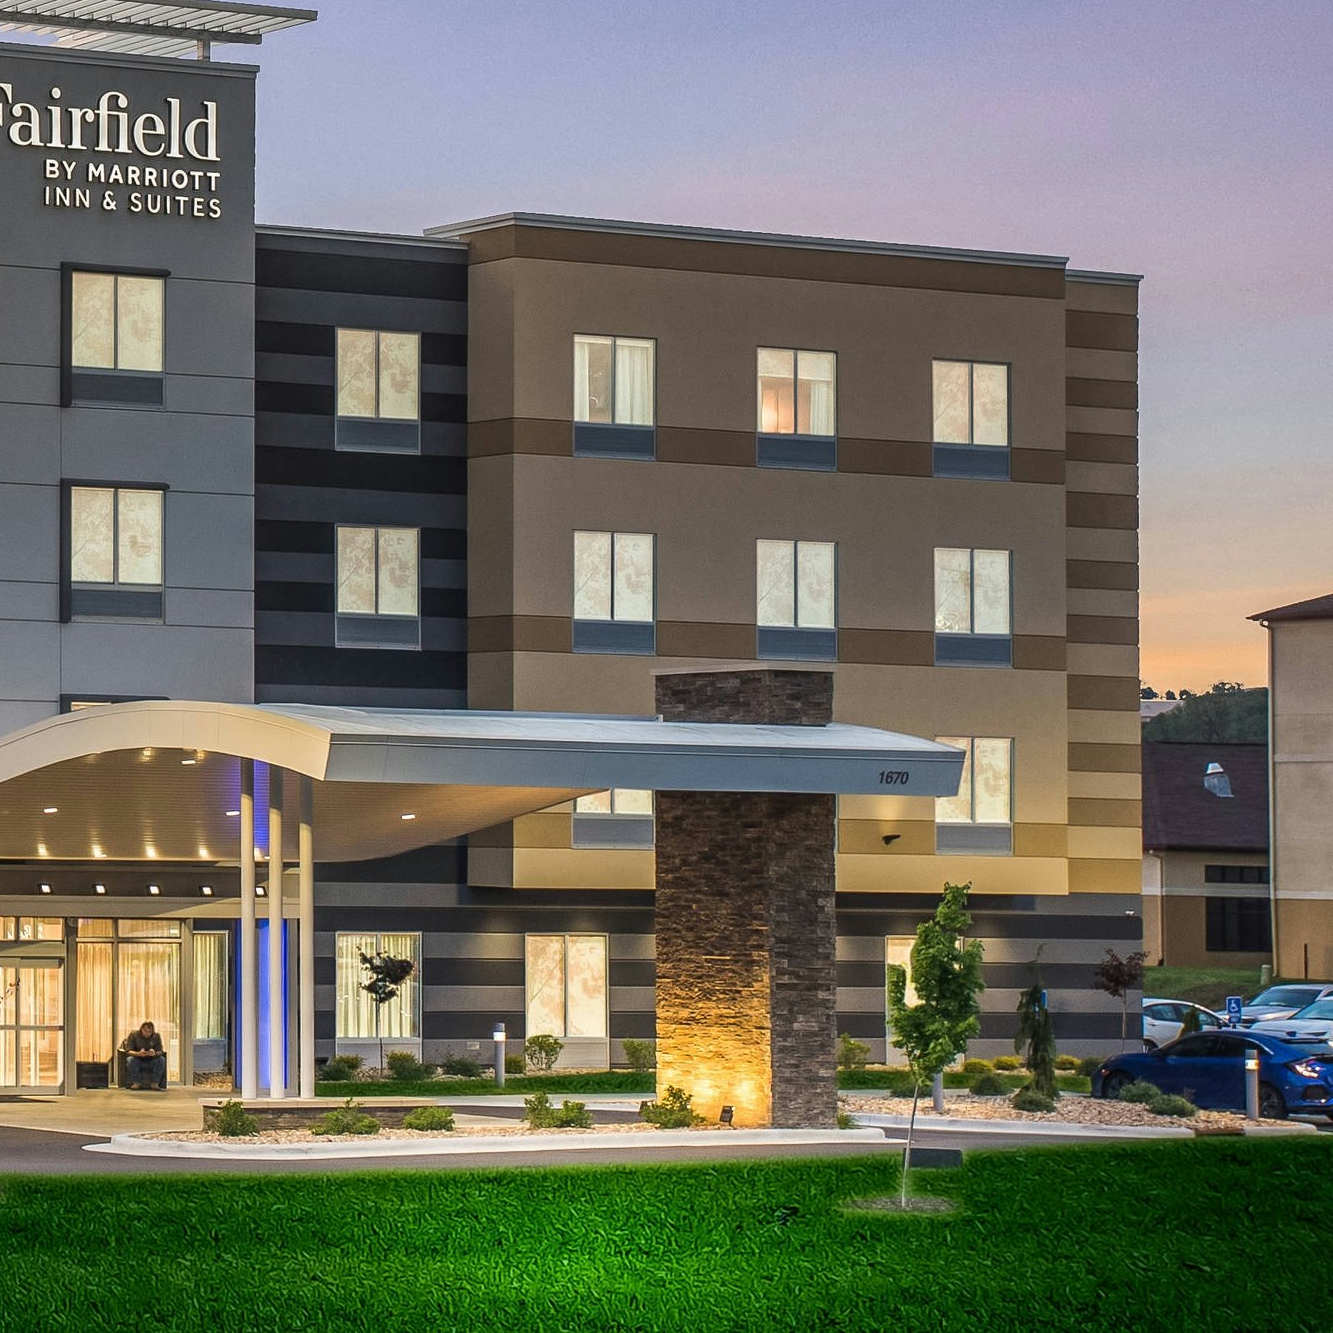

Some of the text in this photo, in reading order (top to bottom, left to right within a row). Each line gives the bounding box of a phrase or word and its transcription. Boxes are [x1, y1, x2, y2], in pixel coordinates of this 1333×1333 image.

[44, 159, 221, 192] BY MARRIOTT
[44, 186, 222, 219] INN & SUITES
[879, 770, 910, 785] 1670
